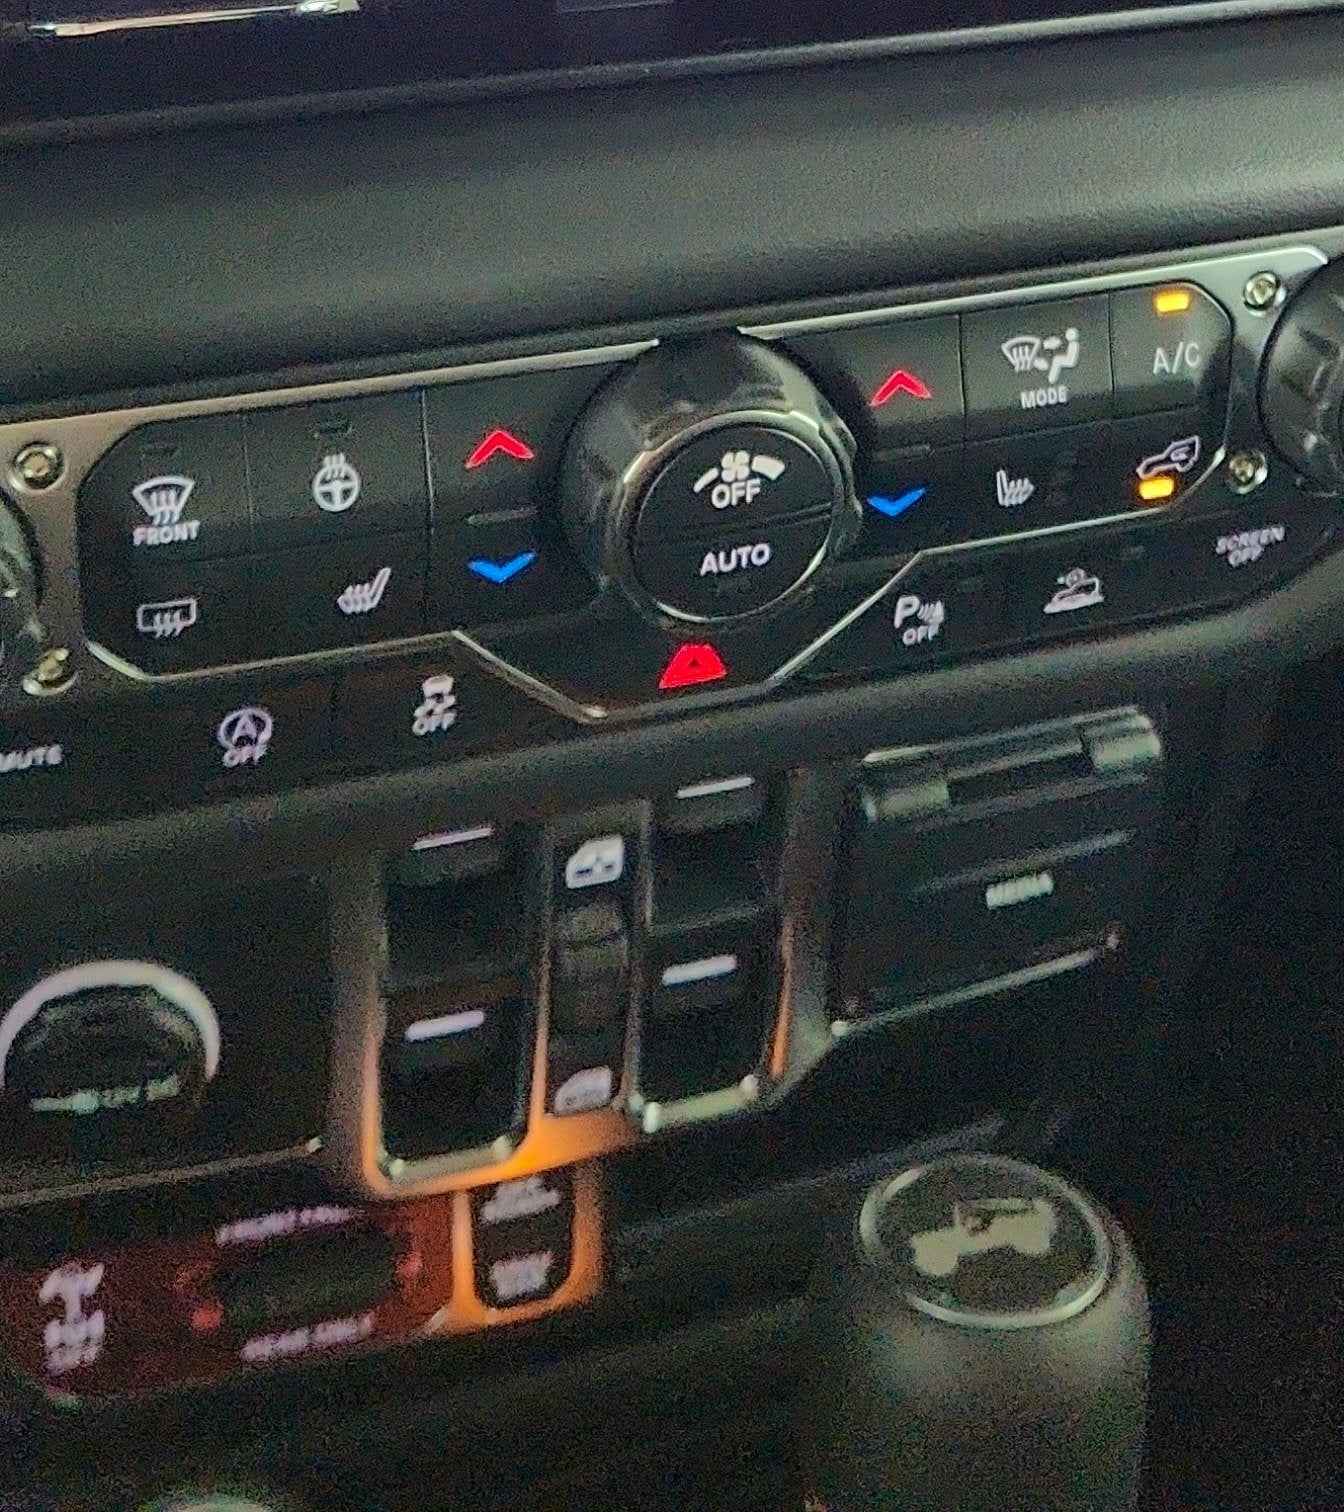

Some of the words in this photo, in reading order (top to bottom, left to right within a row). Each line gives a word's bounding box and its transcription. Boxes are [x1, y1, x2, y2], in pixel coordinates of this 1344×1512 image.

[1153, 341, 1201, 375] A/C
[1021, 385, 1068, 409] MODE
[711, 479, 761, 509] OFF
[133, 520, 200, 546] FRONT
[700, 543, 771, 576] AUTO
[902, 625, 940, 646] OFF
